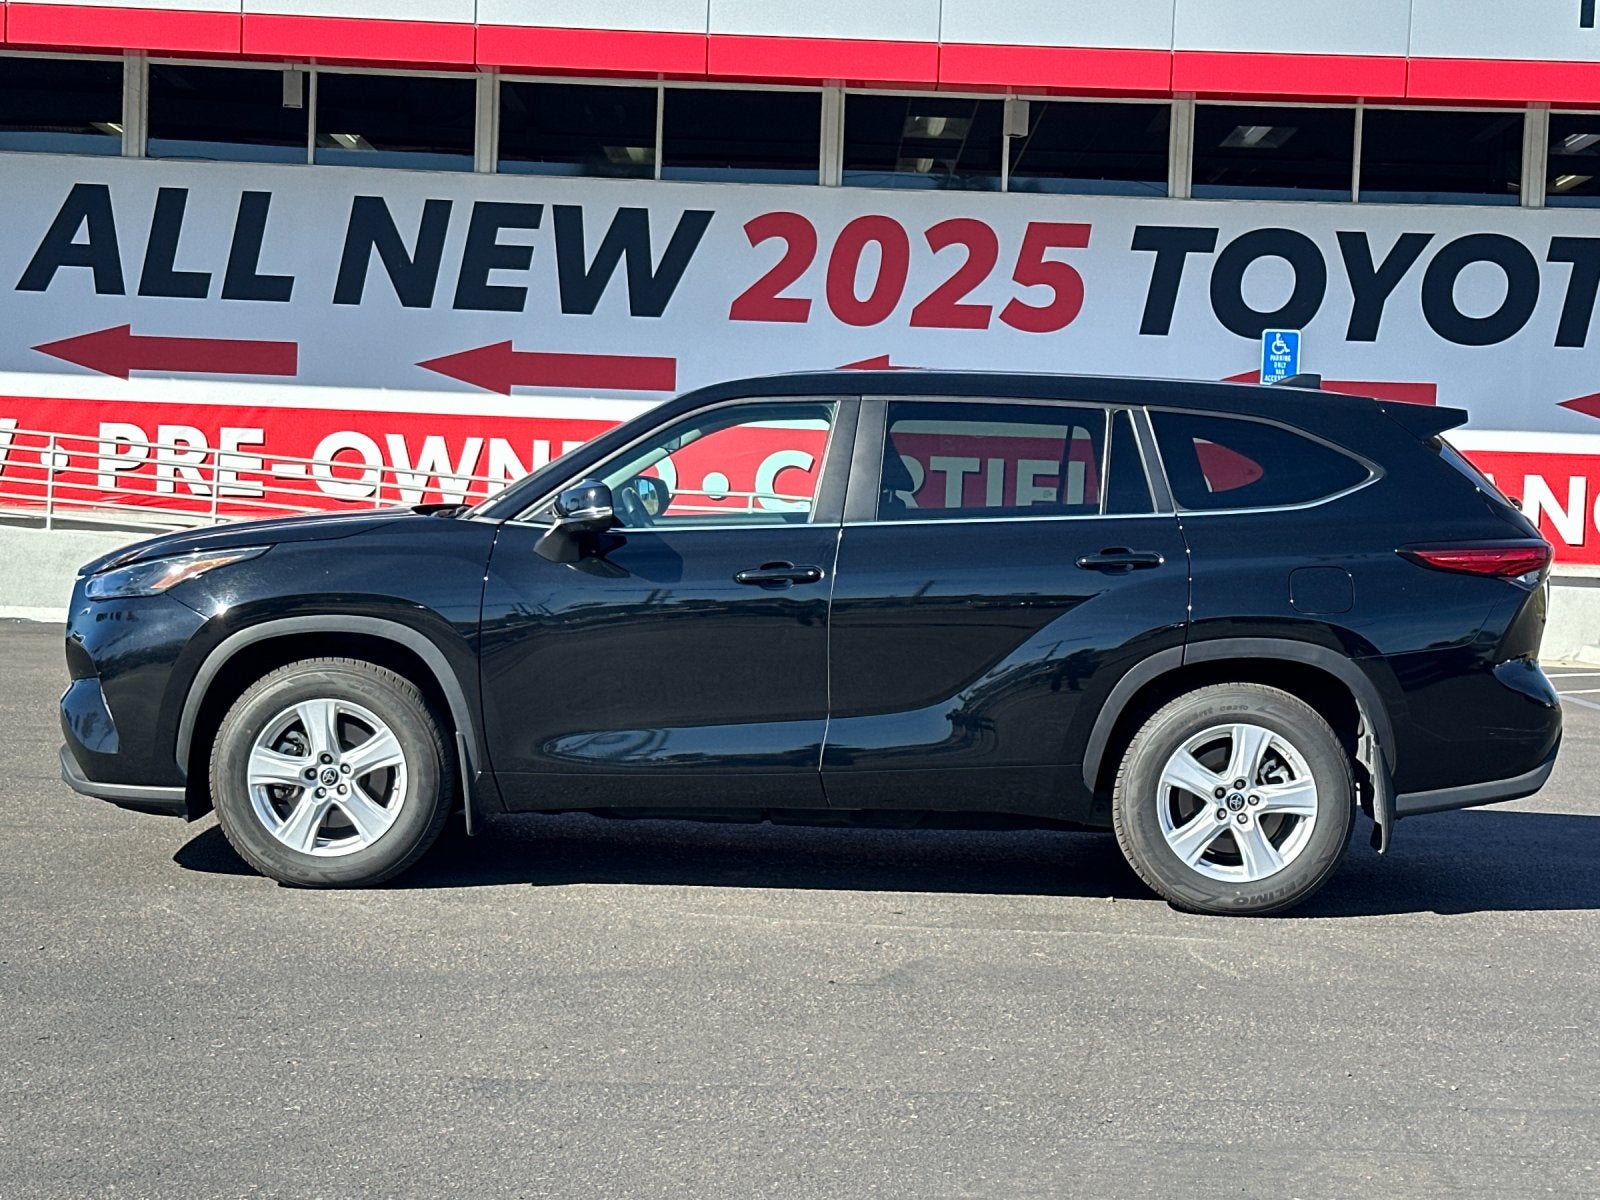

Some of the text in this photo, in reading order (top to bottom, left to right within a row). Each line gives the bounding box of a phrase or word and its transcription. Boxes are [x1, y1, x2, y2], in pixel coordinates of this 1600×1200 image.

[15, 183, 1600, 348] ALL NEW 2025 TOYOT
[97, 422, 677, 505] PRE-OWN
